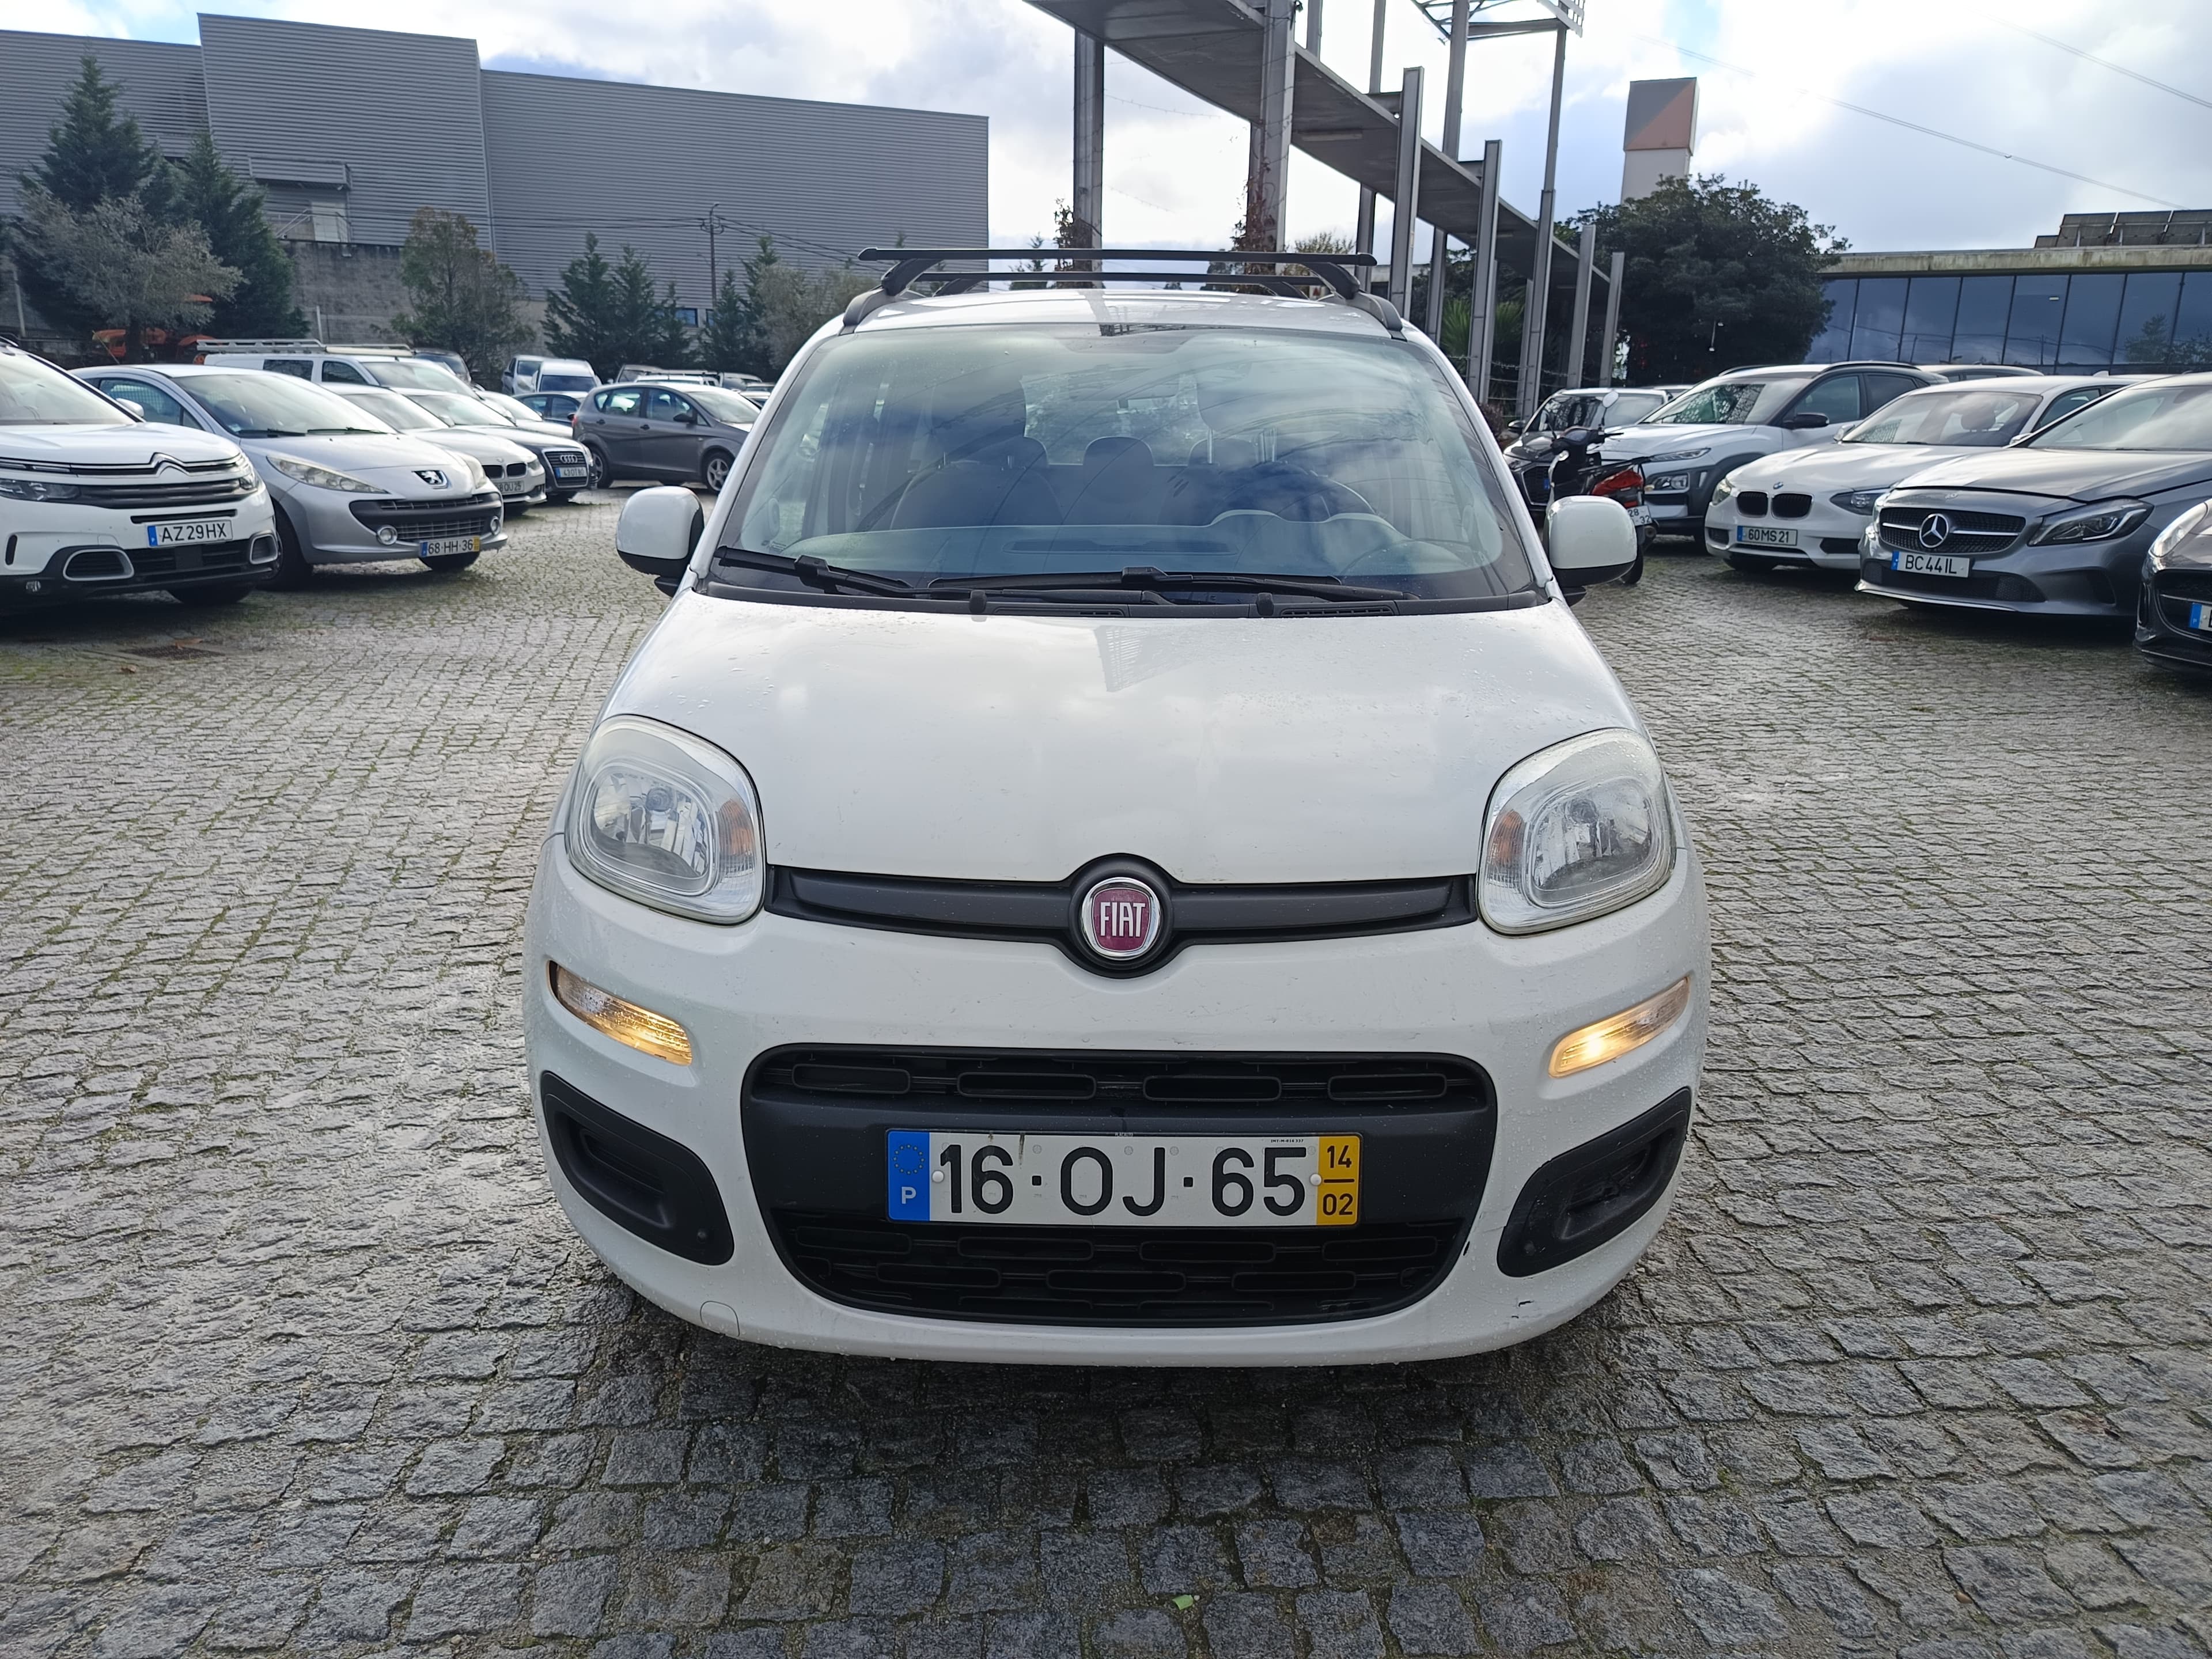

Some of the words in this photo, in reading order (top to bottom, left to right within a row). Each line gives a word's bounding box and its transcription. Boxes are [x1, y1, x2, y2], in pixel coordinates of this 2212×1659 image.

[162, 522, 227, 542] AZ29HX
[1748, 529, 1789, 543] 60MS21
[1905, 555, 1957, 574] BC44IL
[1100, 902, 1146, 937] FIAT
[1327, 1145, 1353, 1169] 14
[901, 1186, 916, 1205] P
[1322, 1193, 1354, 1216] 02
